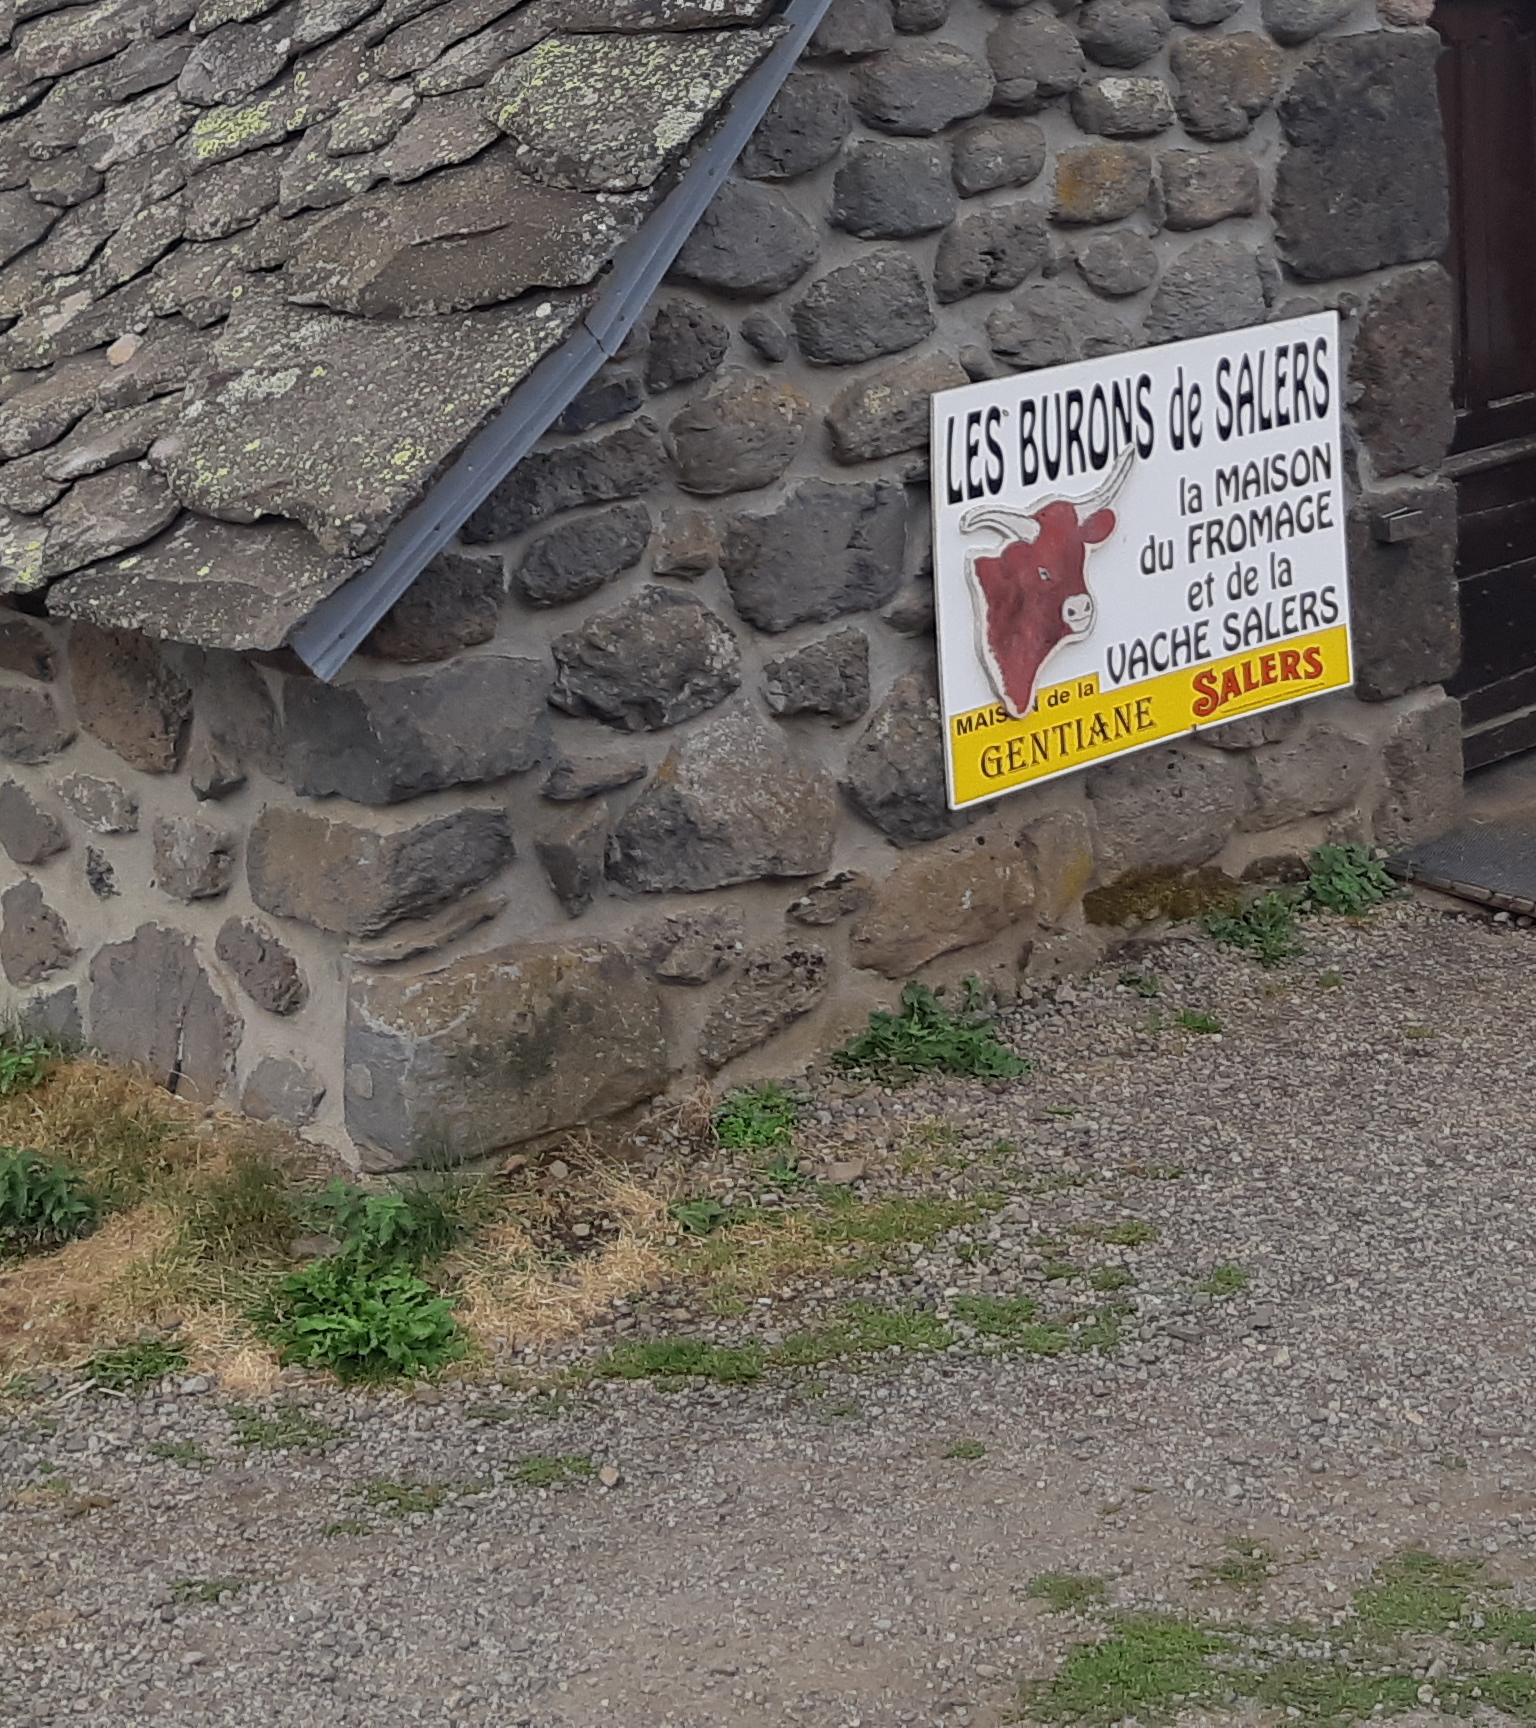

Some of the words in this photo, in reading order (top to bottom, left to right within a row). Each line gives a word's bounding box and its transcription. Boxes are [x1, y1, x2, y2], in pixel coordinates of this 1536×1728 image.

[947, 405, 1004, 505] LES
[1019, 373, 1154, 487] BURONS
[1169, 366, 1202, 451] de
[1216, 336, 1329, 441] SALERS
[1180, 477, 1203, 516] la
[1216, 442, 1332, 507] MAISON
[1140, 535, 1173, 575] du
[1188, 490, 1334, 563] FROMAGE
[1187, 572, 1214, 612] et
[1226, 561, 1259, 601] de
[1270, 551, 1293, 590] la
[1106, 619, 1212, 685] VACHE
[1223, 585, 1339, 652] SALERS
[1047, 689, 1070, 708] de
[1078, 682, 1094, 698] la
[1191, 646, 1324, 718] SALERS
[980, 697, 1156, 780] GENTIANE
